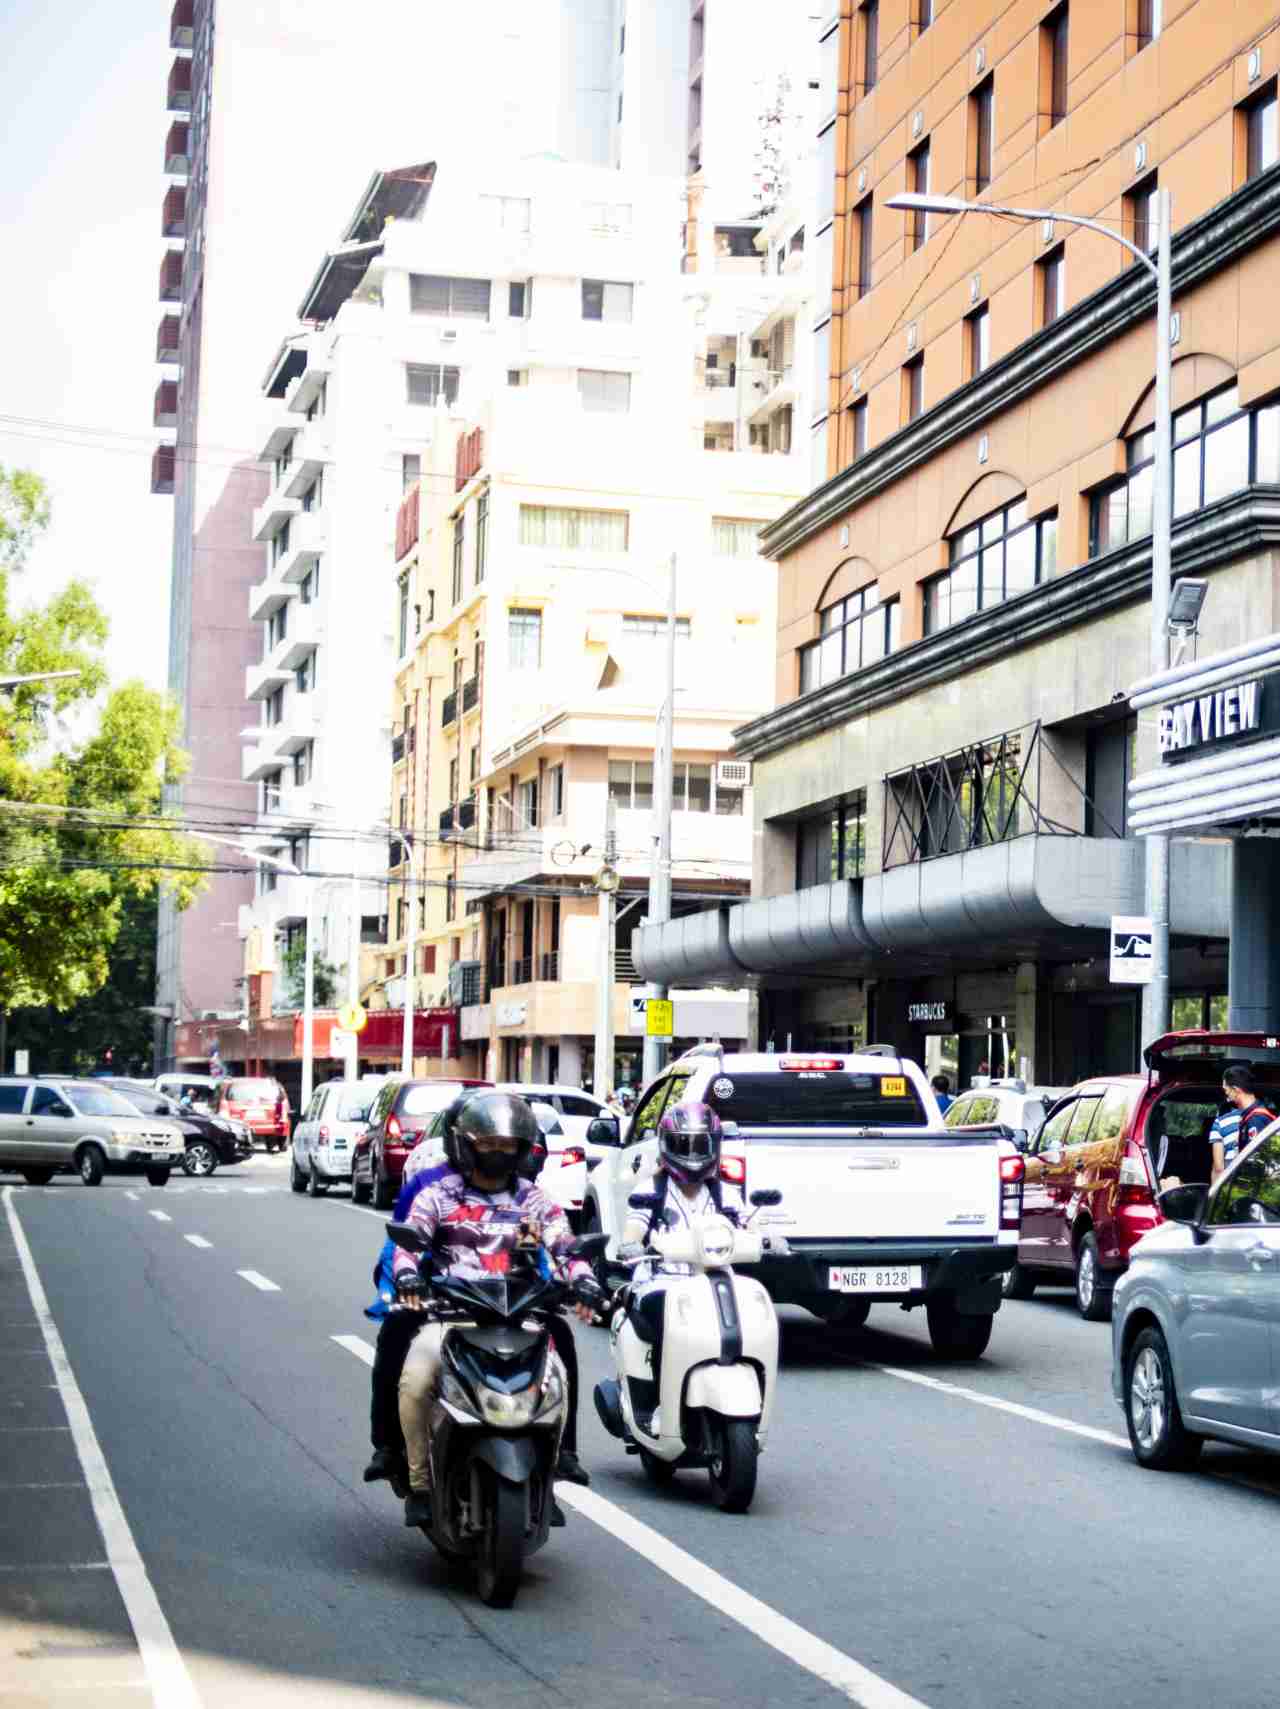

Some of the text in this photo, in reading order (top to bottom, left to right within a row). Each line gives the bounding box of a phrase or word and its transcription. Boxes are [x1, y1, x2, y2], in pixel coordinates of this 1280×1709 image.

[1158, 680, 1260, 752] BAYVIEW
[908, 1002, 945, 1021] STARBUCKS
[842, 1272, 908, 1286] NGR 8128
